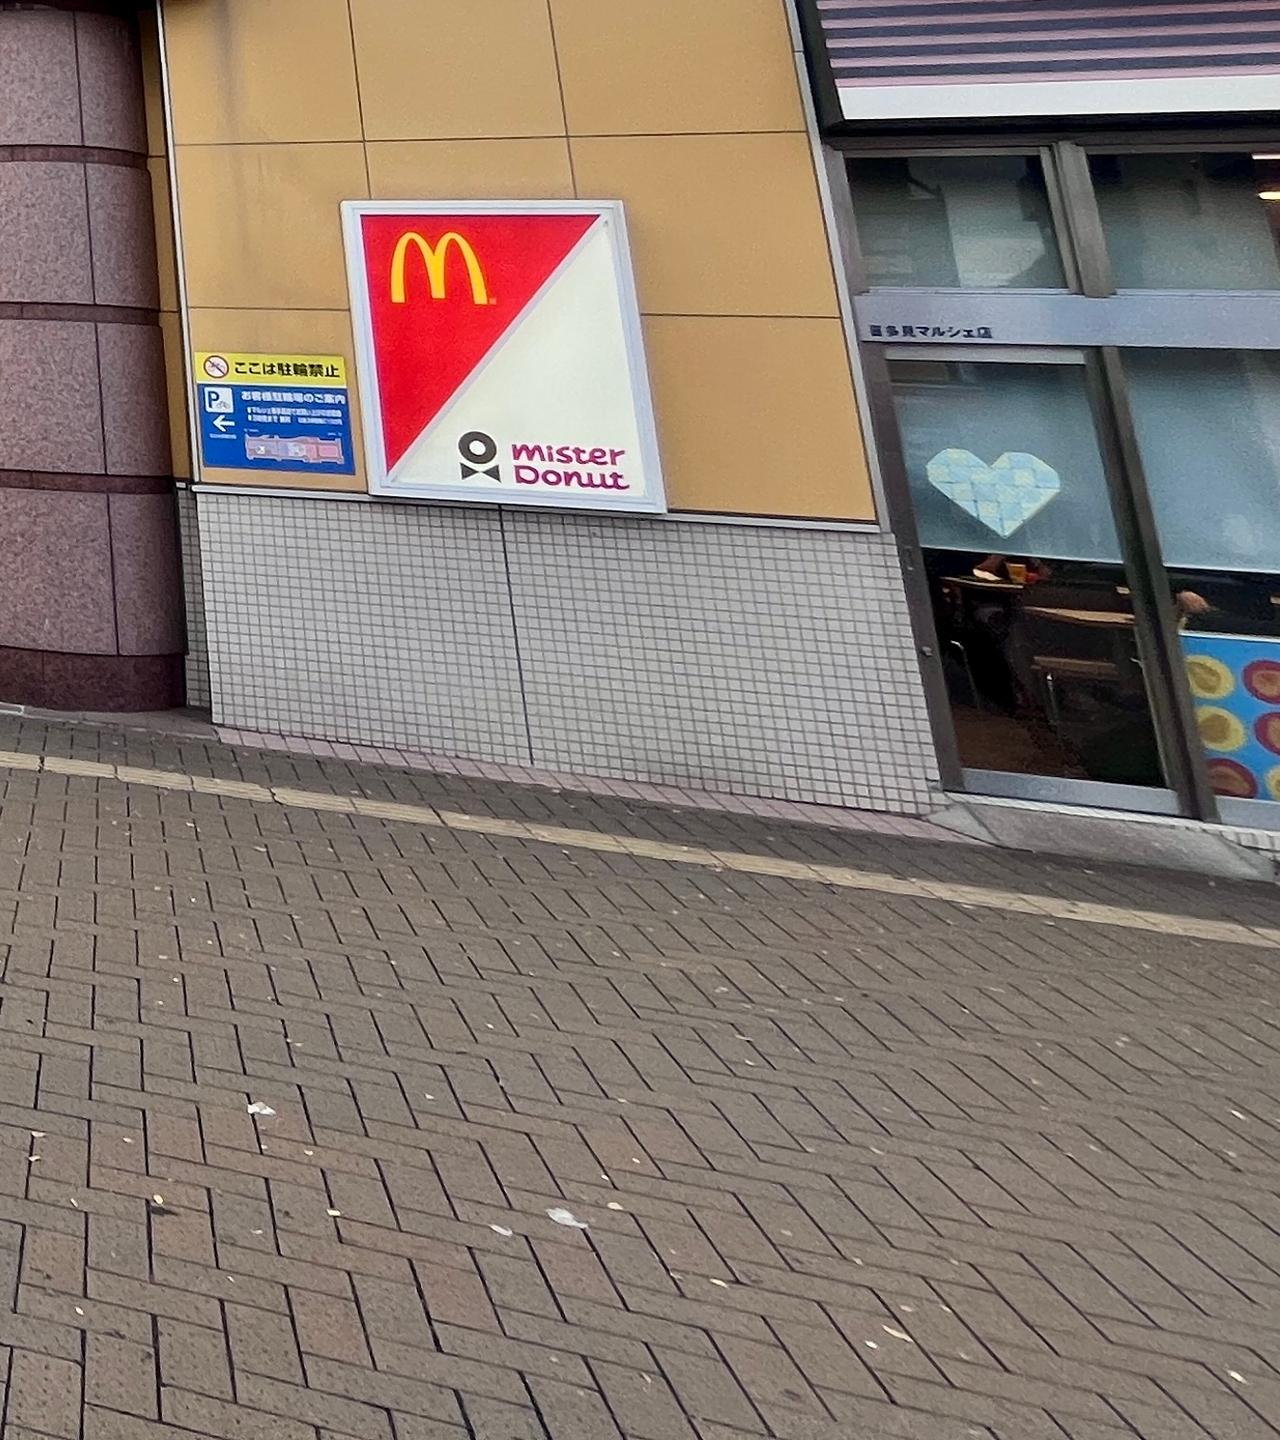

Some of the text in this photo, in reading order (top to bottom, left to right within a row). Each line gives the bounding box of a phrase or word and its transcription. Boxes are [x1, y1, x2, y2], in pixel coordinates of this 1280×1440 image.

[234, 362, 340, 378] ここは駐輪禁止
[514, 465, 630, 490] Donut
